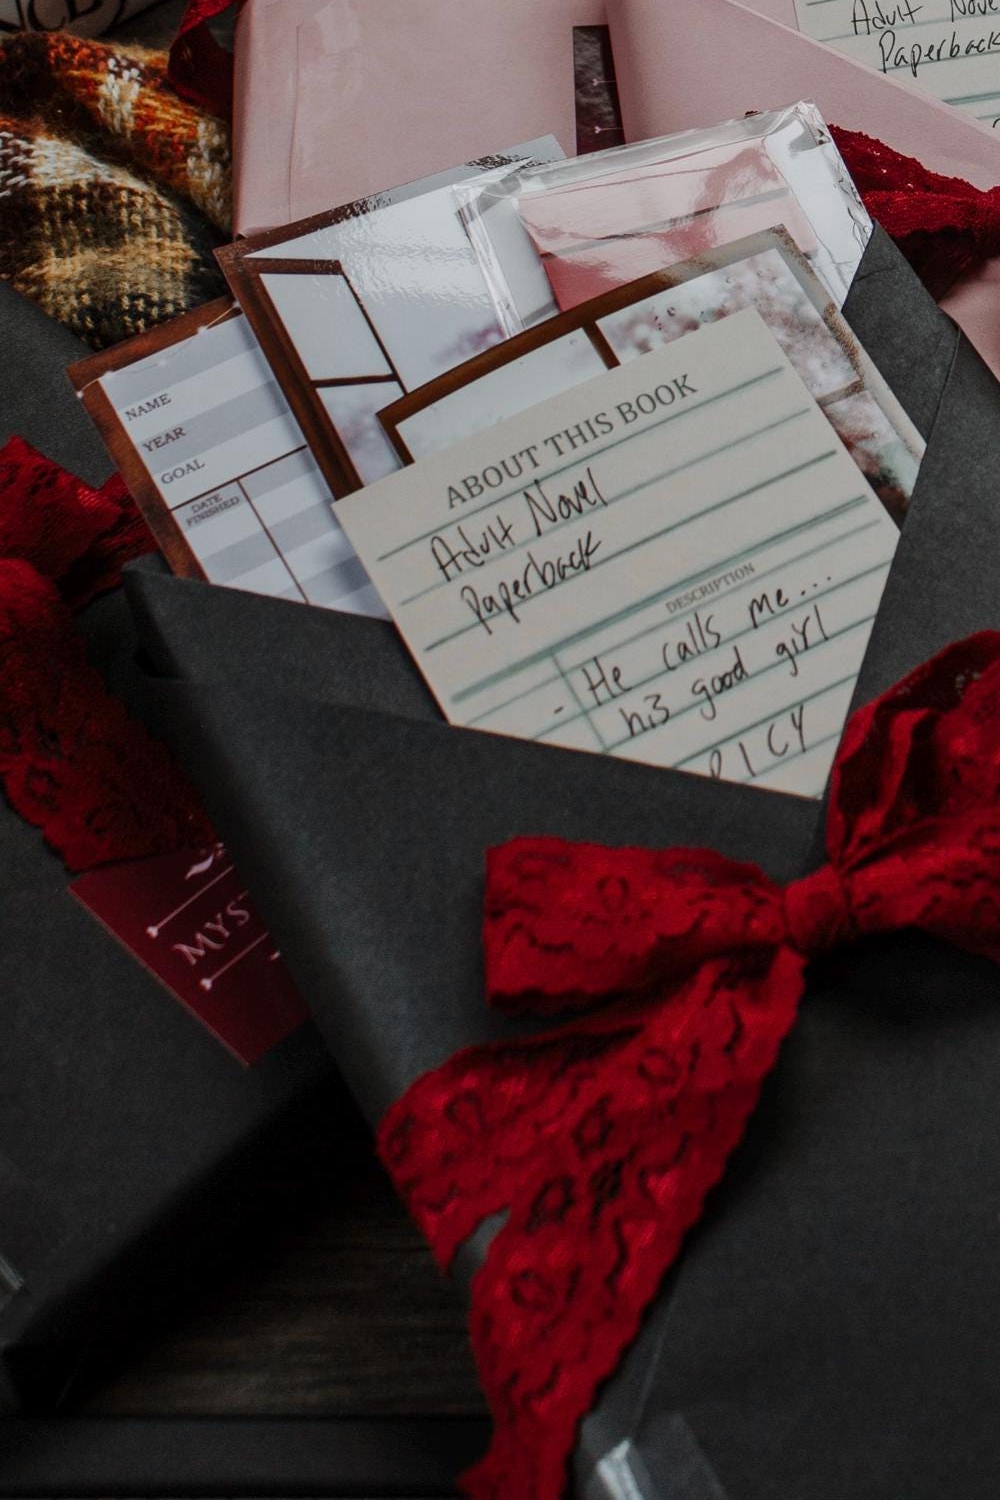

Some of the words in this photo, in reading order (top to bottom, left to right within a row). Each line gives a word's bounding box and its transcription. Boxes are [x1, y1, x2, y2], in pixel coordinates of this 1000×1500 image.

[124, 393, 172, 422] NAME
[141, 426, 187, 453] YEAR
[446, 446, 541, 510] ABOUT
[544, 411, 614, 457] THIS
[620, 374, 699, 427] BOOK
[160, 458, 206, 486] GOAL
[186, 496, 240, 527] FINISHED
[191, 494, 223, 514] DATE
[430, 515, 516, 582] Adult
[523, 467, 609, 537] Novel
[461, 531, 602, 635] Paperback
[665, 561, 756, 614] DESCRIPTION
[581, 656, 632, 707] He
[662, 611, 721, 672] calls
[692, 645, 749, 721] good
[776, 604, 829, 677] girl
